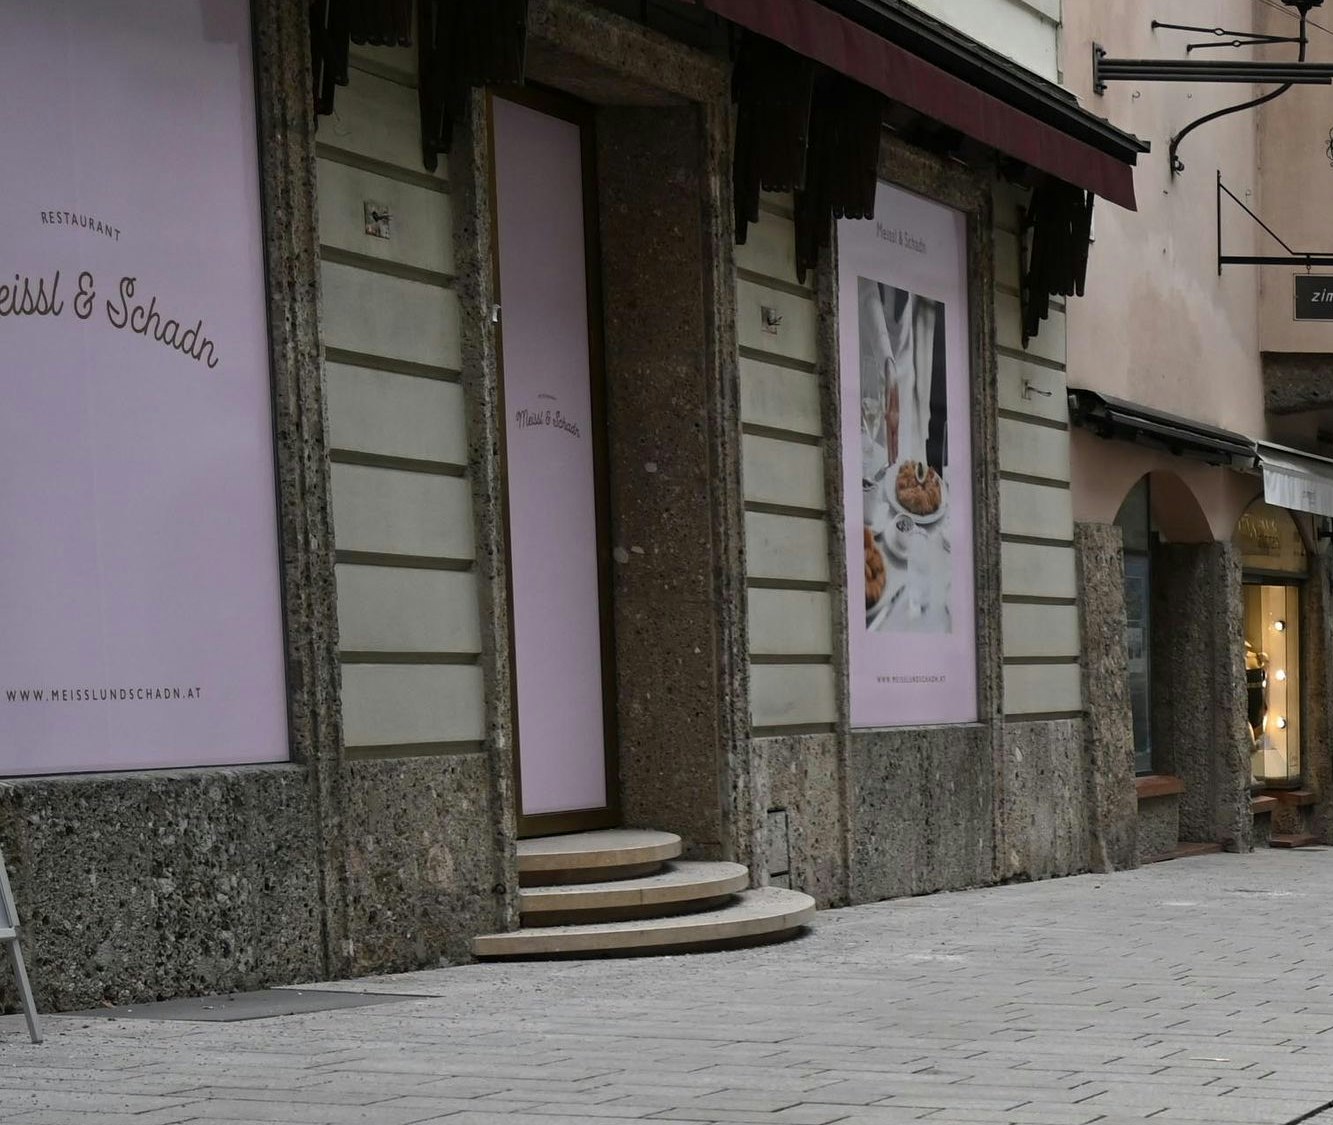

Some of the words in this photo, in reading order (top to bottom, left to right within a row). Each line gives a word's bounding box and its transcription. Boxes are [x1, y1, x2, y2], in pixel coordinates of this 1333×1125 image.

[41, 211, 121, 241] RESTAURANT
[0, 270, 64, 317] eissl
[74, 271, 96, 320] &
[106, 276, 219, 369] Schadn
[6, 687, 201, 702] WWW.MEISSLUNDSCHADN.AT
